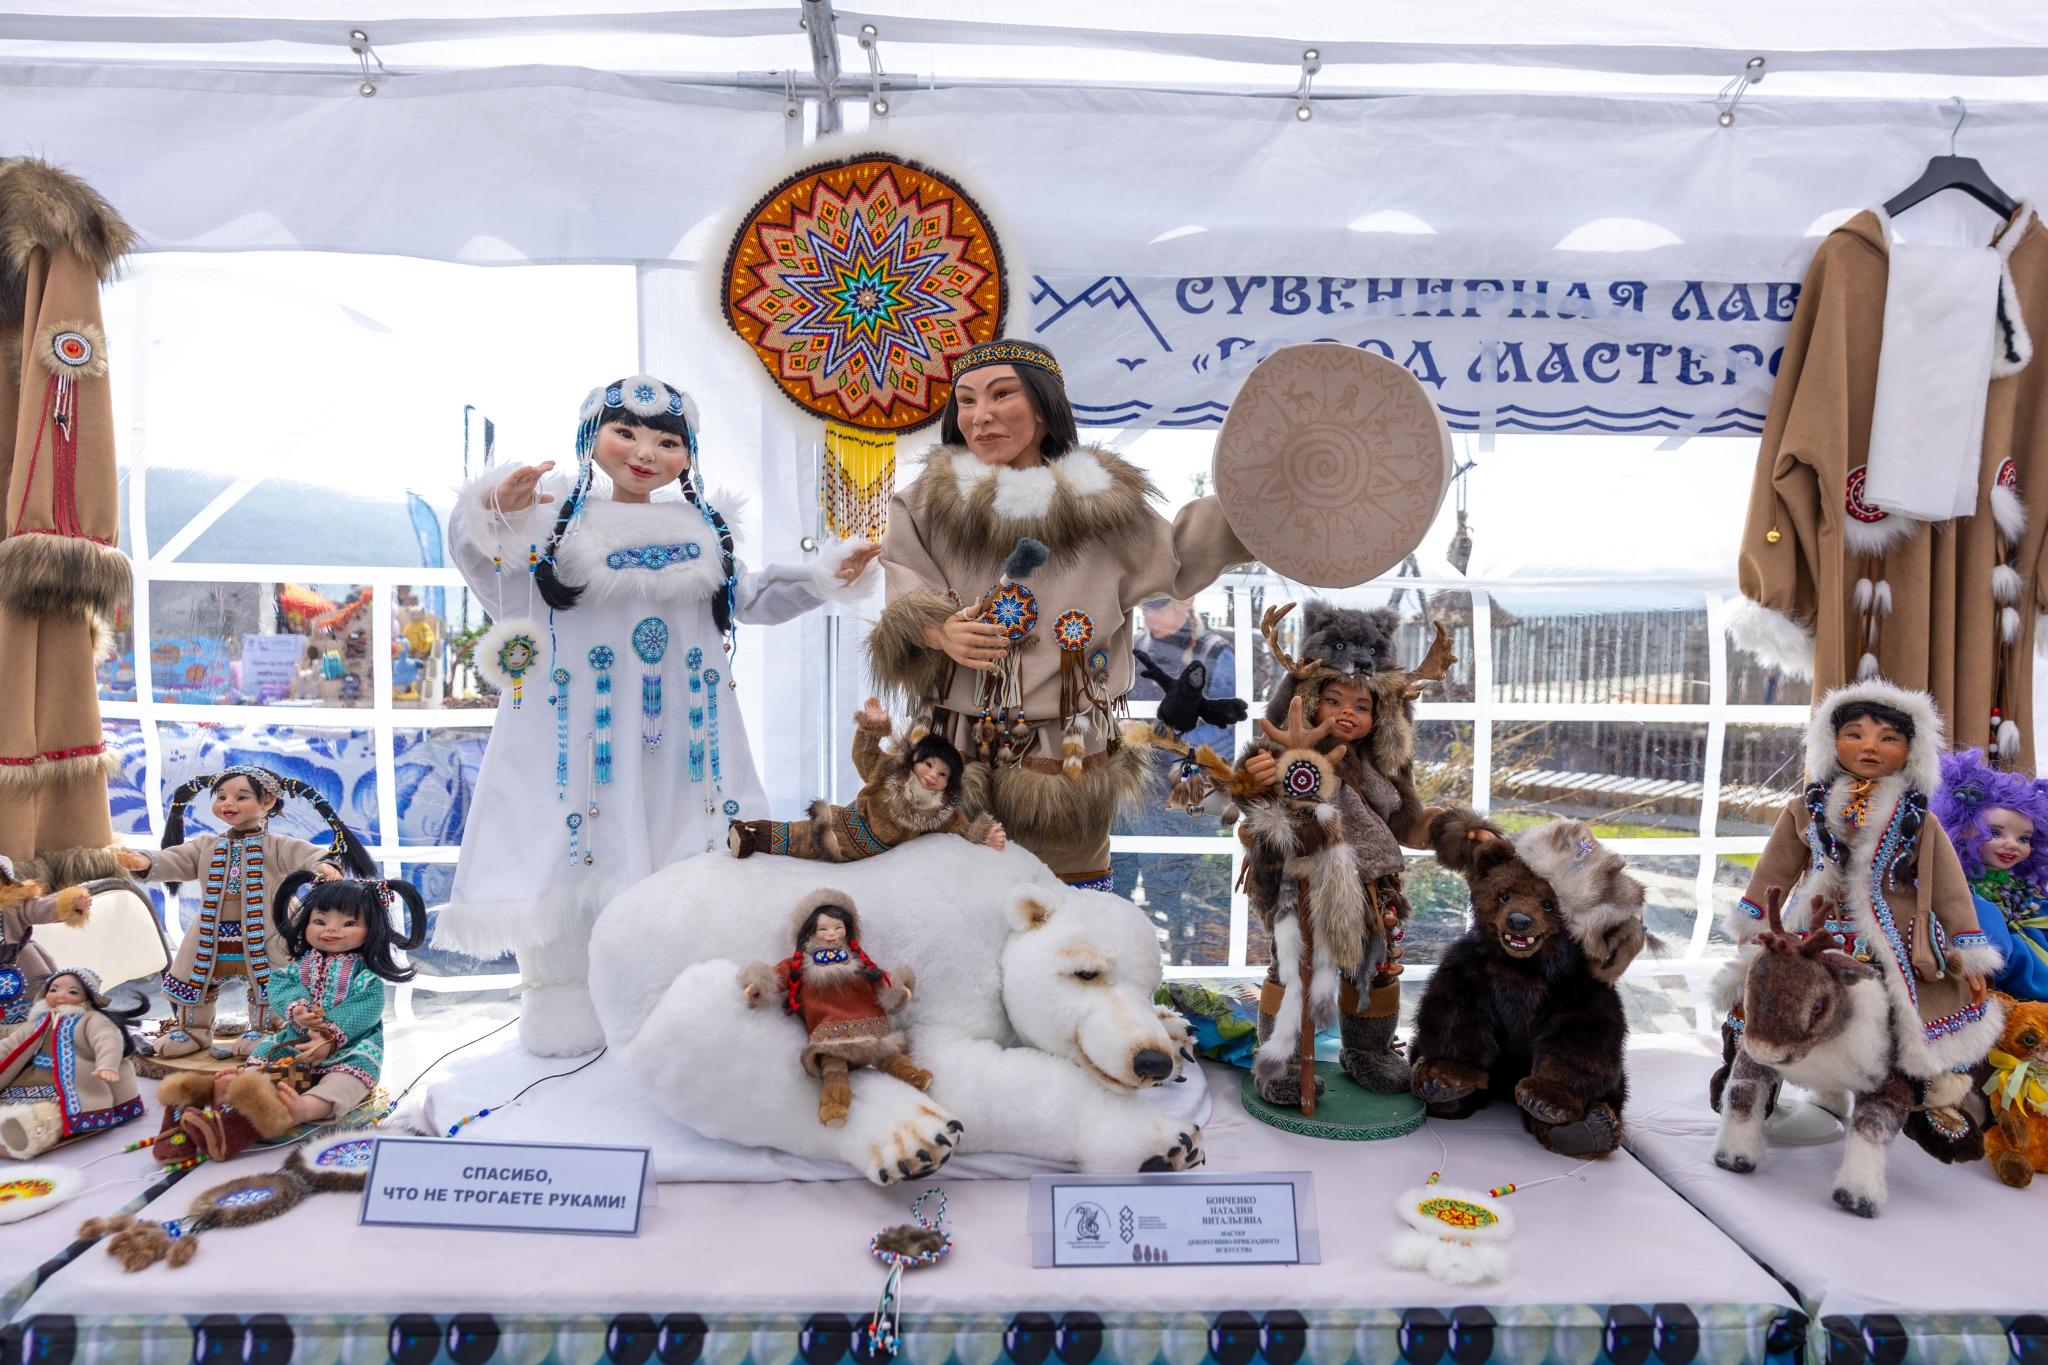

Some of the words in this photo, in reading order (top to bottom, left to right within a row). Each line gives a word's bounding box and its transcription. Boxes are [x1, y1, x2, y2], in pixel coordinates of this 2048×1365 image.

[1175, 275, 1648, 321] СУВЕНИРНАЯ
[462, 1166, 553, 1185] СПАСИБО,
[382, 1186, 419, 1201] ЧТО
[423, 1188, 448, 1202] НЕ
[453, 1189, 544, 1205] ТРОГАЕТЕ
[548, 1193, 627, 1209] РУКАМИ!
[1205, 1196, 1257, 1205] БОНЧЕНКО
[1210, 1206, 1254, 1215] НАТАЛИЯ
[1201, 1216, 1263, 1225] ВИТАЛЬЕВНА
[1187, 1238, 1280, 1246] ДЕКОРАТИВНО-ПРИКЛАДНОГО
